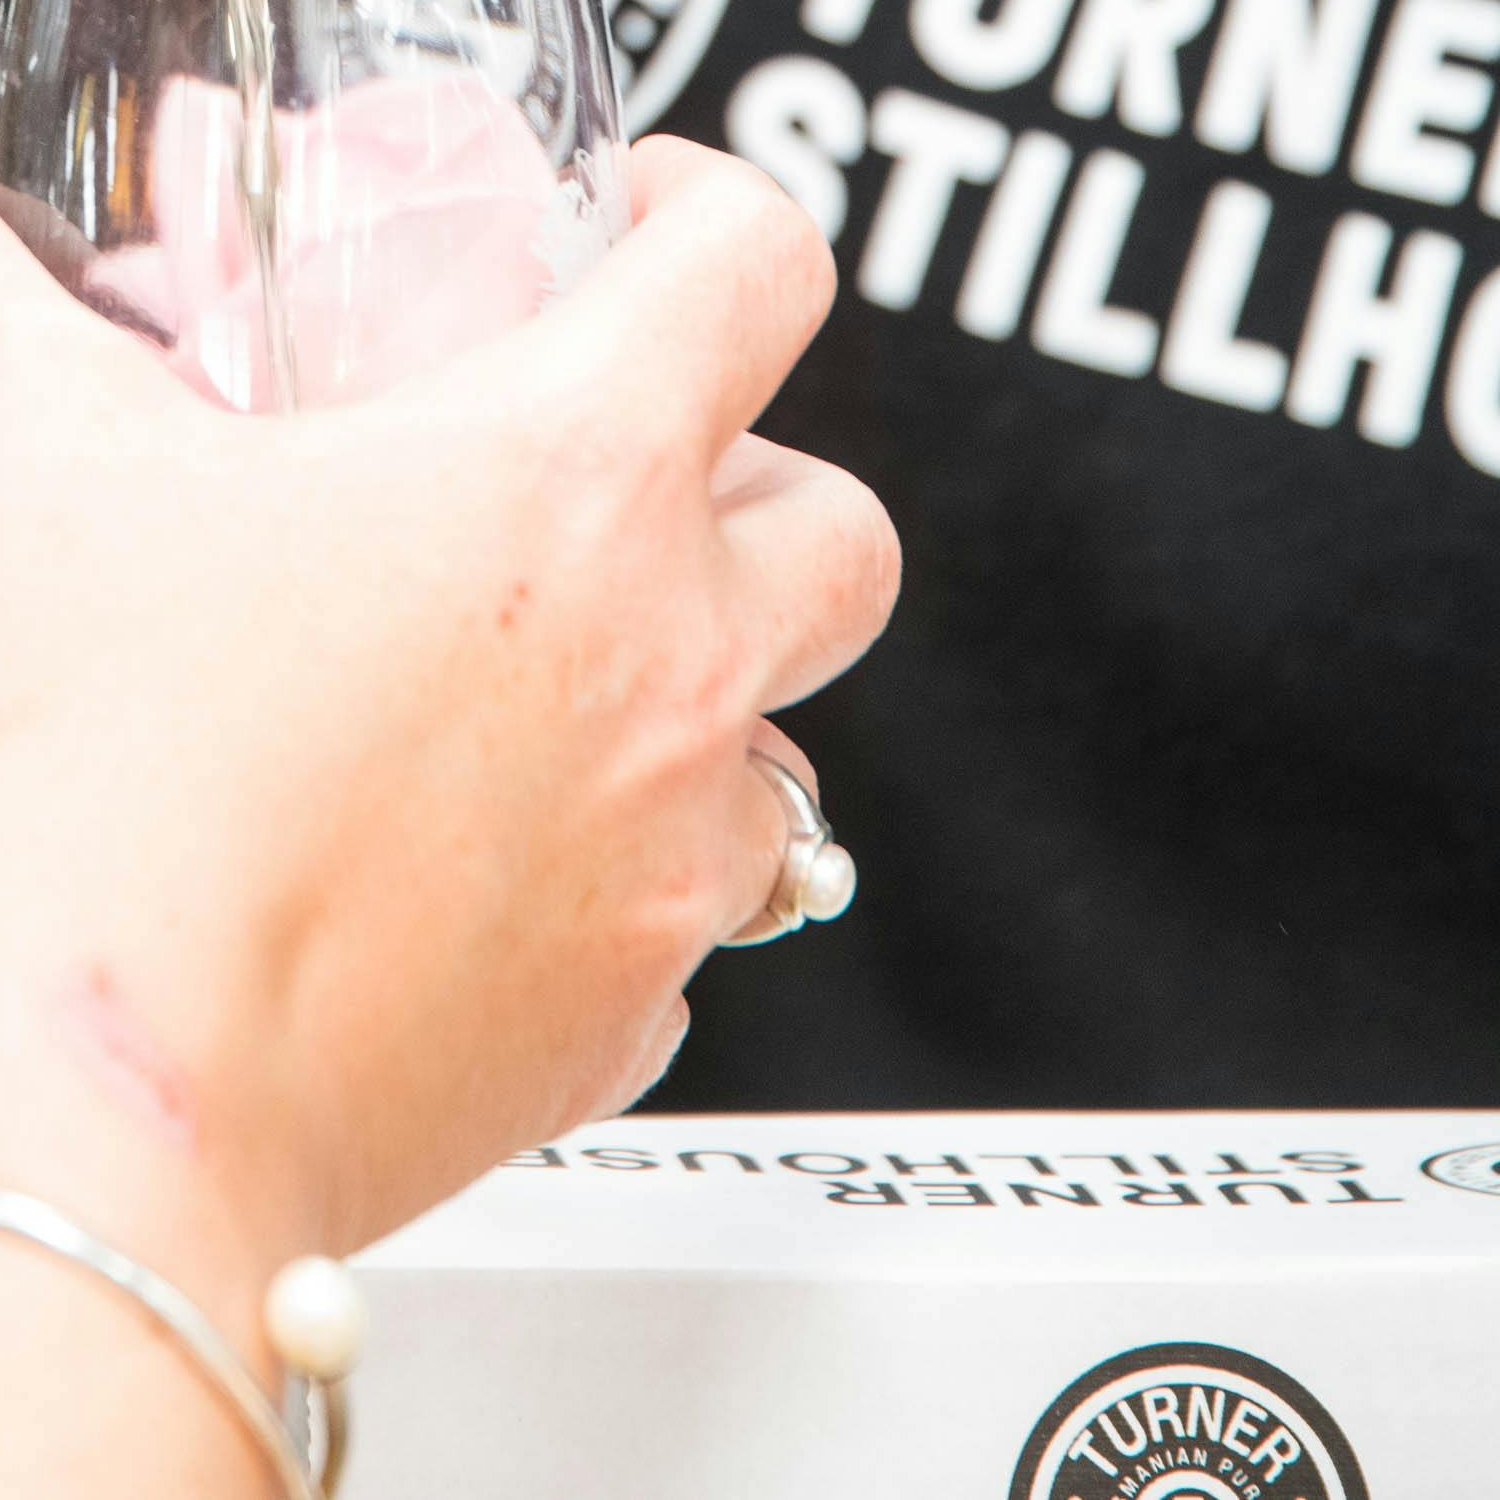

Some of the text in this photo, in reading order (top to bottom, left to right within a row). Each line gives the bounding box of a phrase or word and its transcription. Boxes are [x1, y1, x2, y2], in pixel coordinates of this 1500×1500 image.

[821, 1180, 1404, 1206] TURNER
[1067, 1386, 1302, 1484] TURNER
[1111, 1447, 1263, 1500] MANIAN PUR
